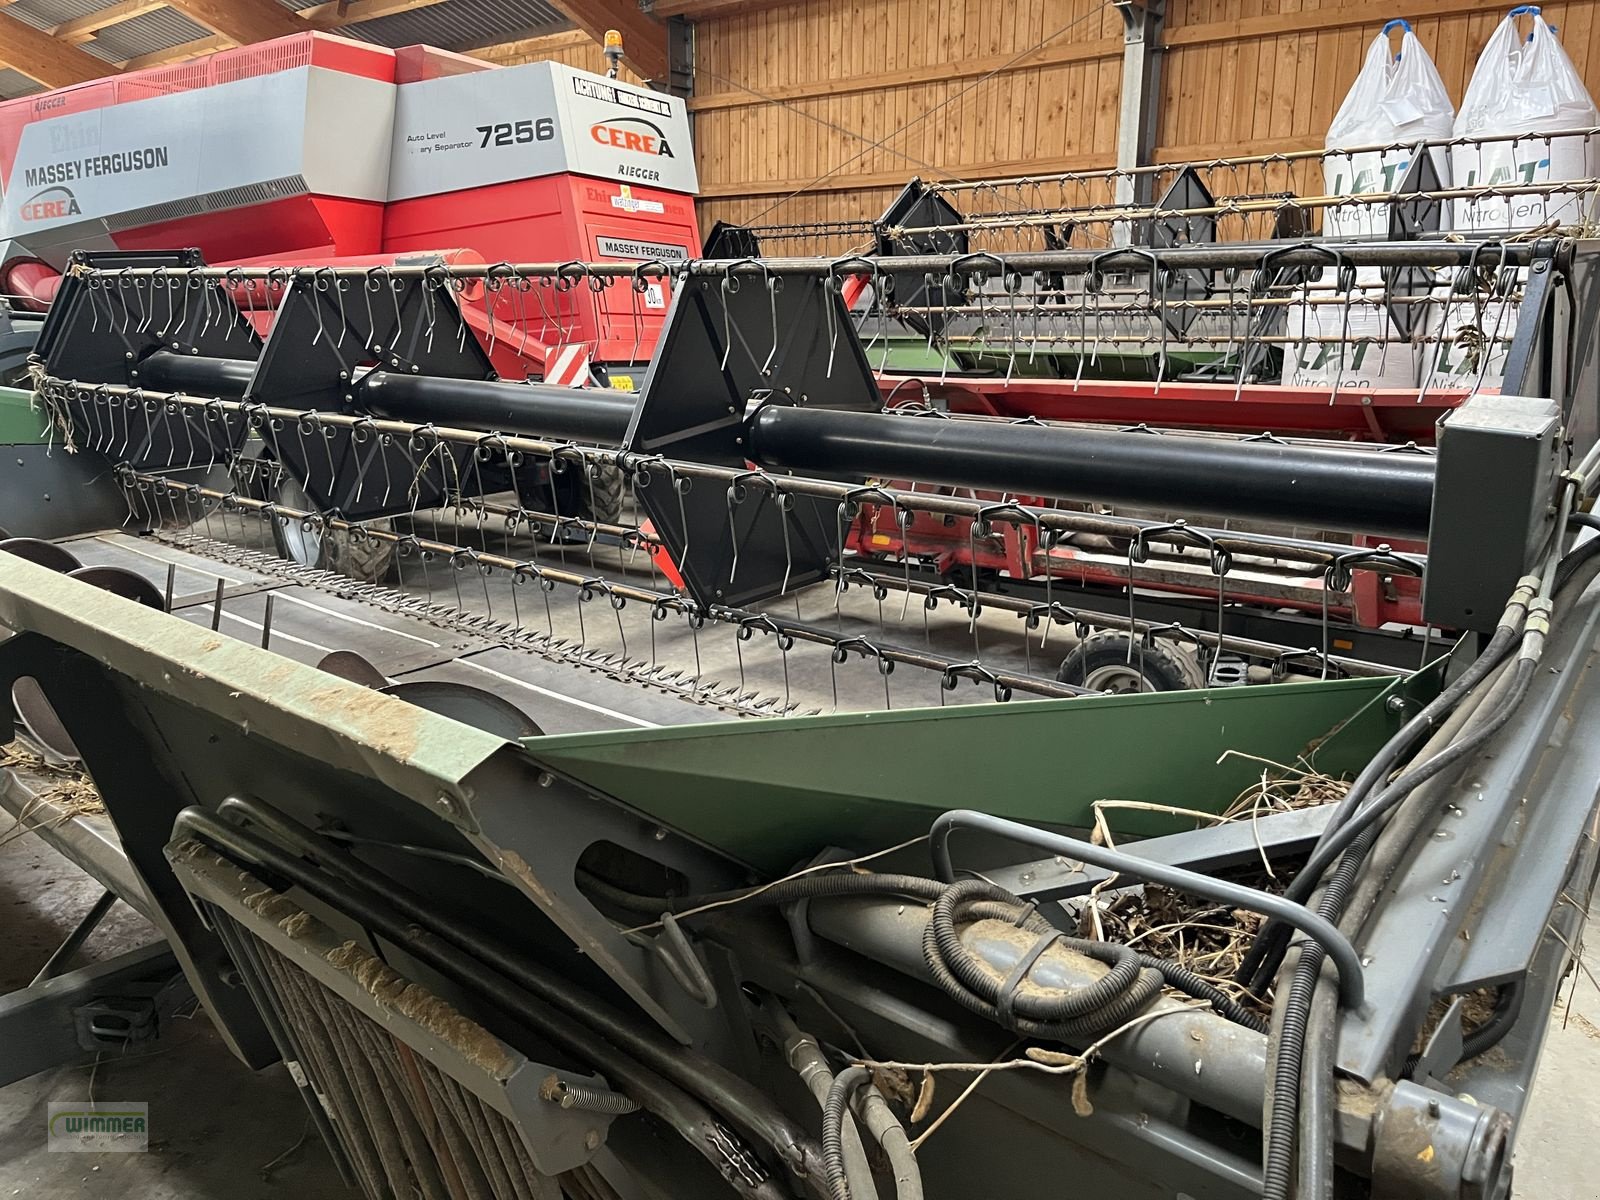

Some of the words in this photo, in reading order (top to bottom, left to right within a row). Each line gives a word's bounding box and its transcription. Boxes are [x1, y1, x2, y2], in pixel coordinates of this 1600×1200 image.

[575, 78, 617, 104] ACHTUNG!
[34, 96, 66, 112] RIEGGER
[407, 135, 424, 143] Auto
[426, 131, 446, 141] Level
[476, 117, 554, 149] 7256
[590, 124, 676, 159] CEREA
[434, 141, 473, 152] Separator
[25, 160, 82, 188] MASSEY
[84, 146, 168, 178] FERGUSON
[618, 164, 660, 181] RIEGGER
[20, 198, 82, 222] CEREA
[605, 242, 639, 254] MASSEY
[641, 246, 682, 259] FERGUSON
[1297, 341, 1371, 371] LAT
